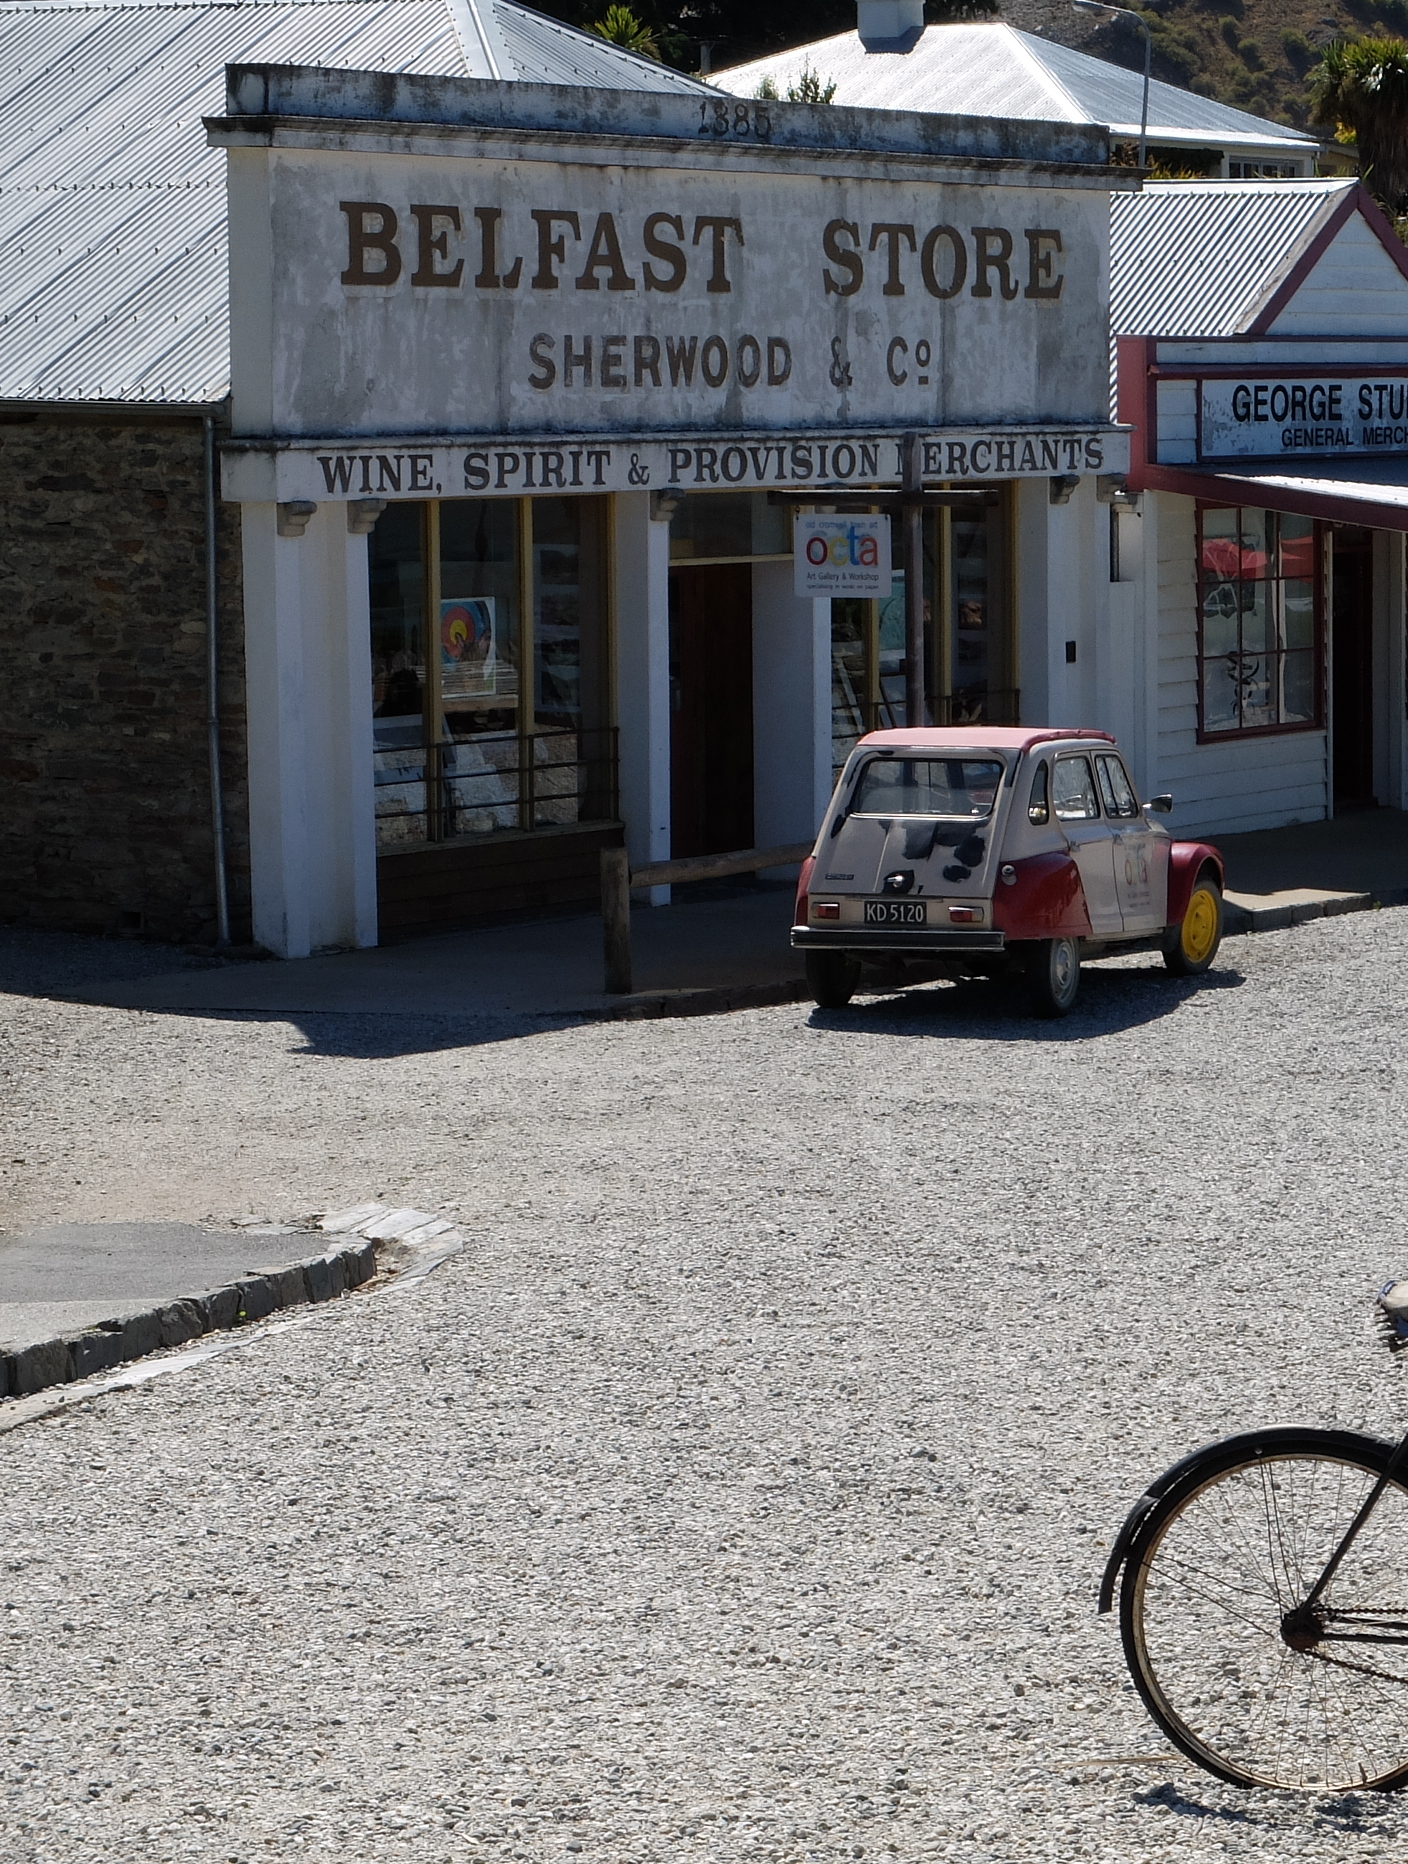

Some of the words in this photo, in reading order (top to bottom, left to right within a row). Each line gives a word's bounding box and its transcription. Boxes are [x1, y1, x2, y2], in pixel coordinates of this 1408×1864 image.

[699, 100, 772, 139] 1885
[339, 201, 745, 293] BELFAST
[822, 219, 1064, 299] STORE
[527, 333, 793, 390] SHERWOOD
[829, 335, 853, 388] &
[1231, 383, 1343, 423] GEORGE
[1281, 427, 1354, 448] GENERAL
[317, 454, 443, 495] WINE,
[463, 450, 611, 491] SPIRIT
[627, 453, 651, 485] &
[667, 444, 880, 483] PROVISION
[806, 526, 879, 567] octa
[807, 572, 816, 580] Art
[818, 572, 839, 582] Gallery
[848, 572, 879, 582] Workshop
